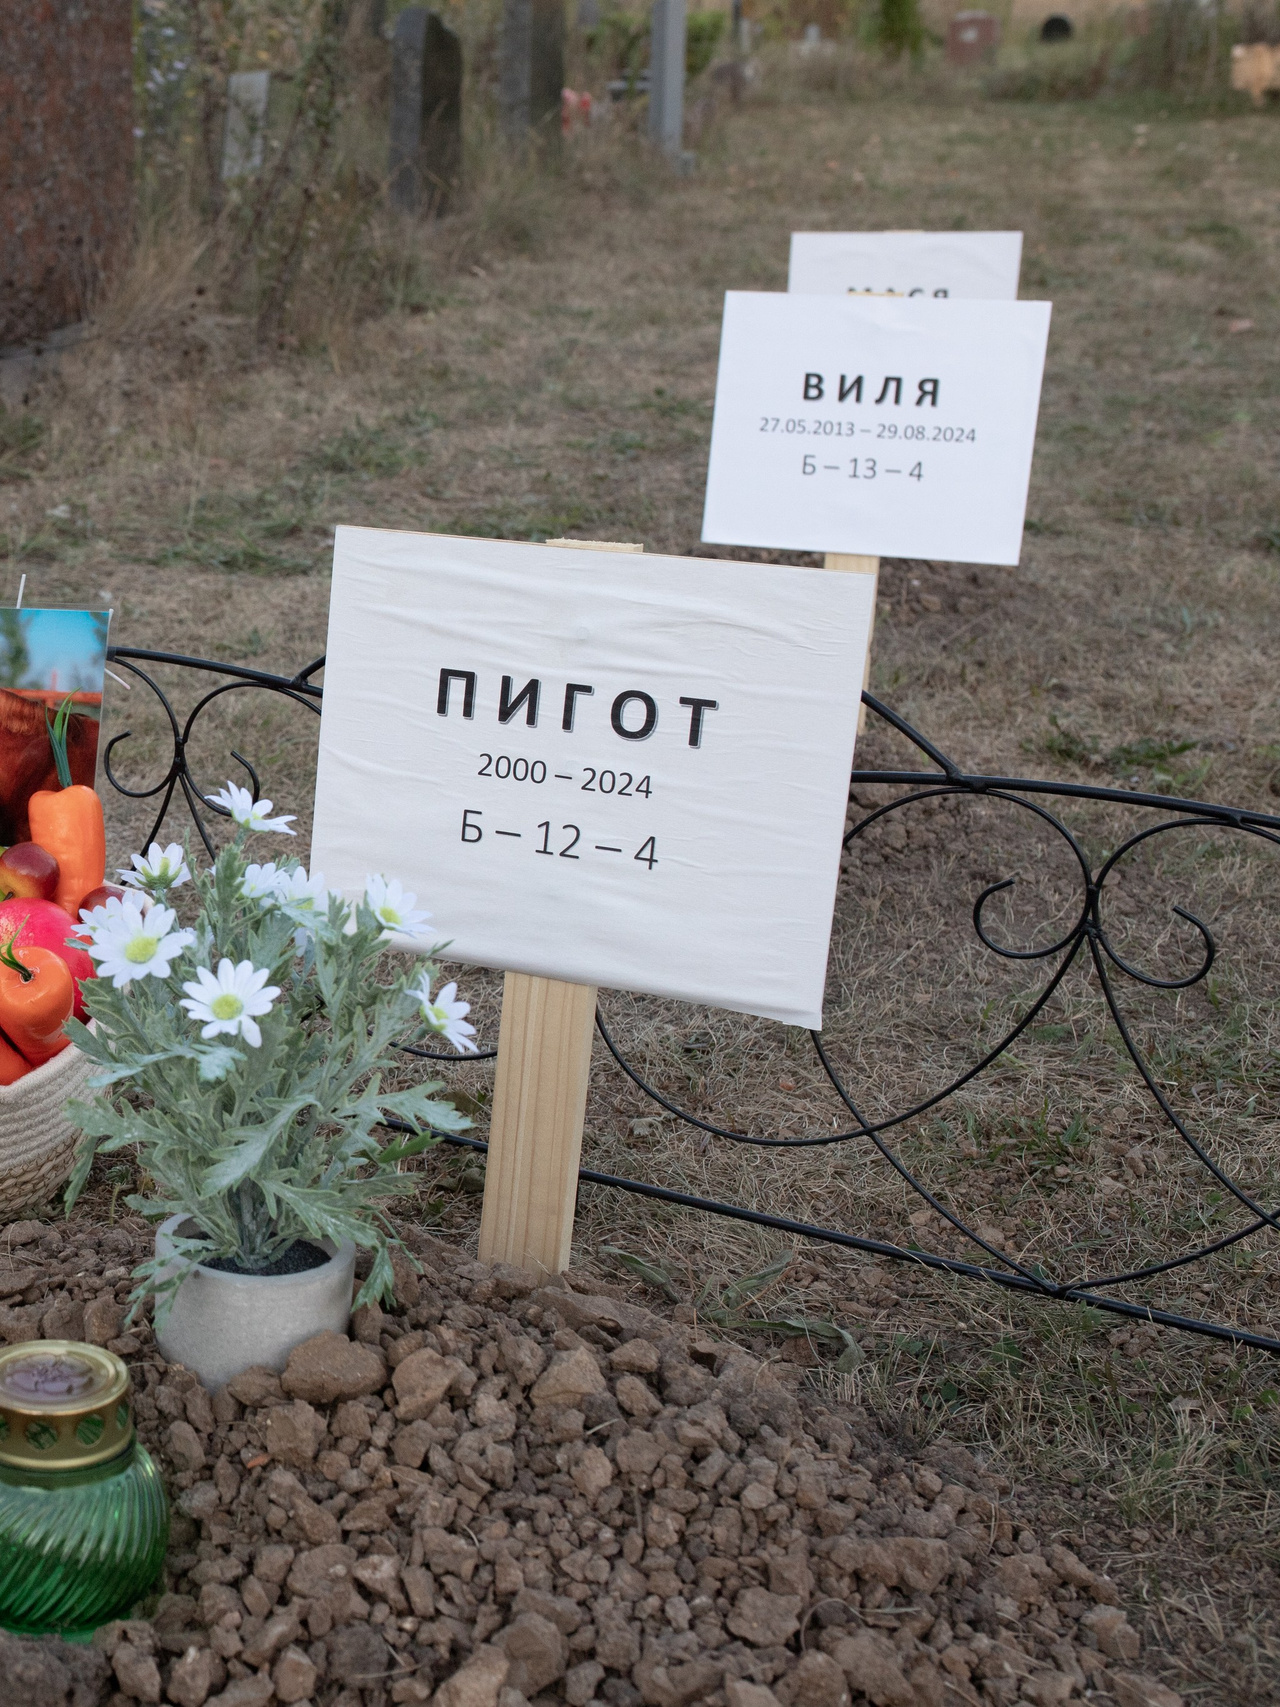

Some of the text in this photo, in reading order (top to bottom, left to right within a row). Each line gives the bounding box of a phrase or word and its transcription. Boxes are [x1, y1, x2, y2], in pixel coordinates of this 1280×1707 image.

[802, 372, 940, 408] ВИЛЯ
[759, 417, 855, 437] 27.05.2013
[876, 423, 977, 443] 29.08.2024
[802, 454, 817, 476] Б
[848, 457, 878, 480] 13
[908, 461, 924, 482] 4
[436, 668, 719, 748] ПИГОТ
[477, 752, 547, 784] 2000
[580, 767, 653, 799] 2024
[461, 809, 483, 843] Б
[535, 820, 581, 859] 12
[633, 836, 659, 870] 4
